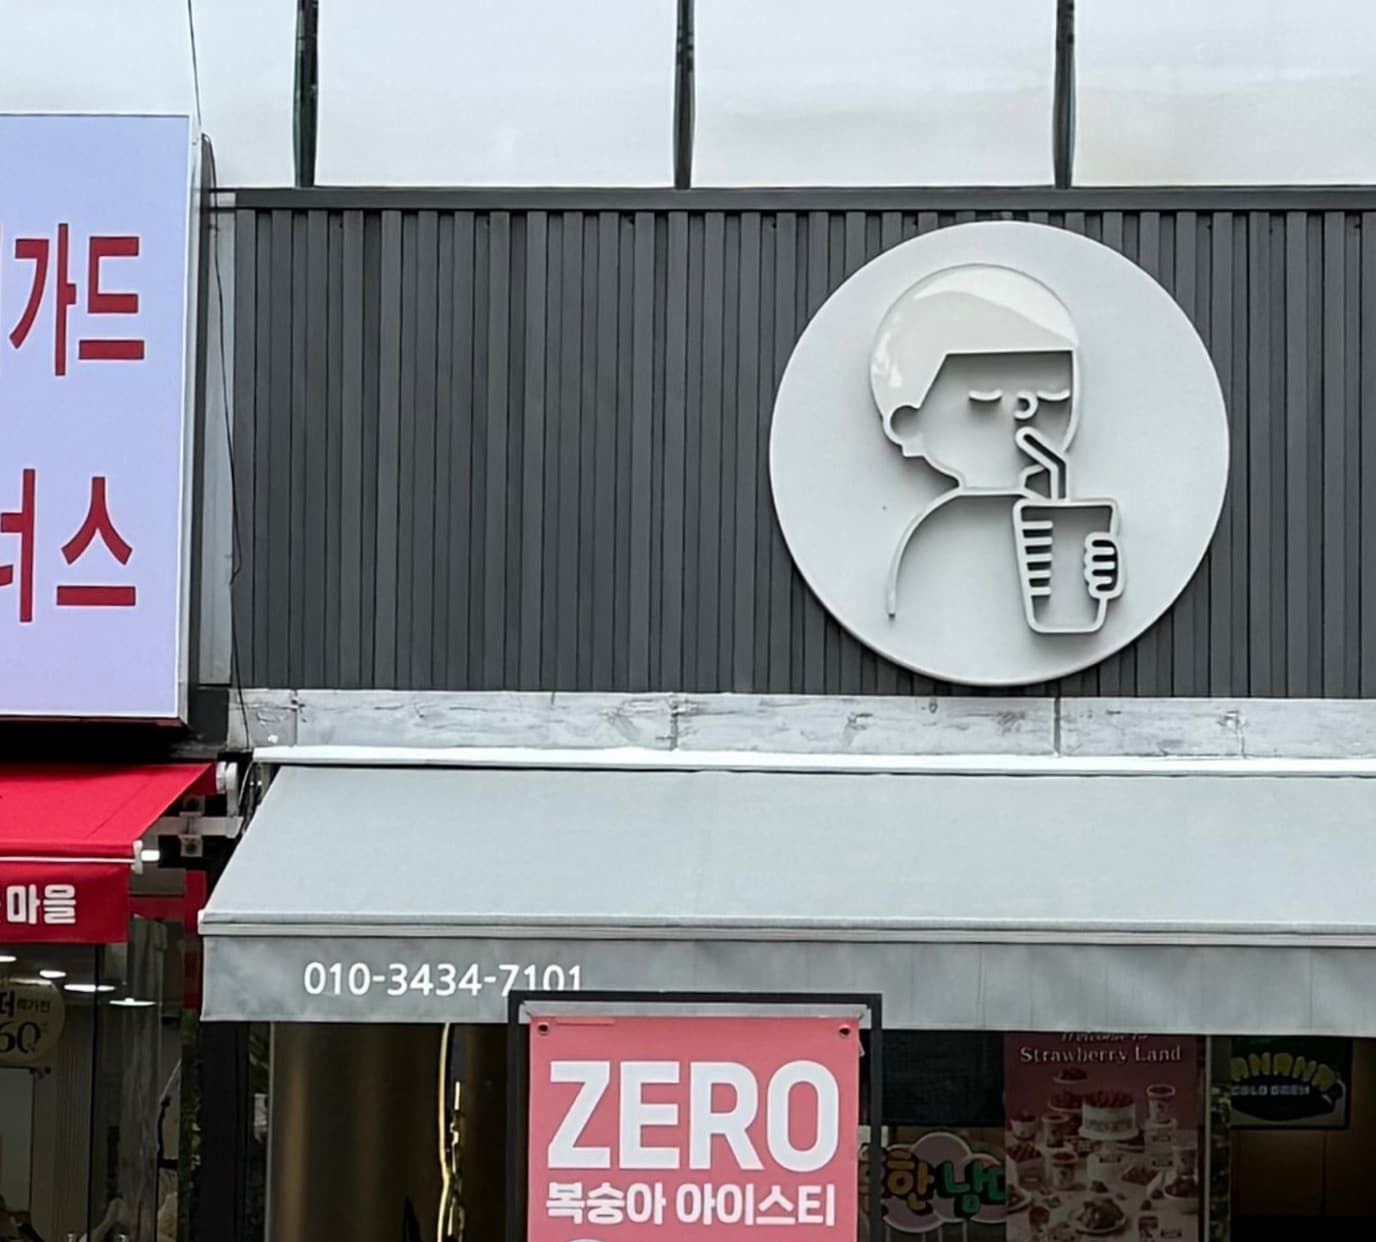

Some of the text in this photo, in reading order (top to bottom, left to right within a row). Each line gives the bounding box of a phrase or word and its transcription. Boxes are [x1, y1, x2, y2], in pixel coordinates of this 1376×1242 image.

[9, 223, 145, 376] 가드
[7, 884, 76, 925] 마을
[304, 962, 582, 997] 010-3434-7101
[1019, 1045, 1182, 1065] Strawberry Land
[547, 1060, 839, 1172] ZERO
[546, 1181, 836, 1226] 복숭아 아이스티
